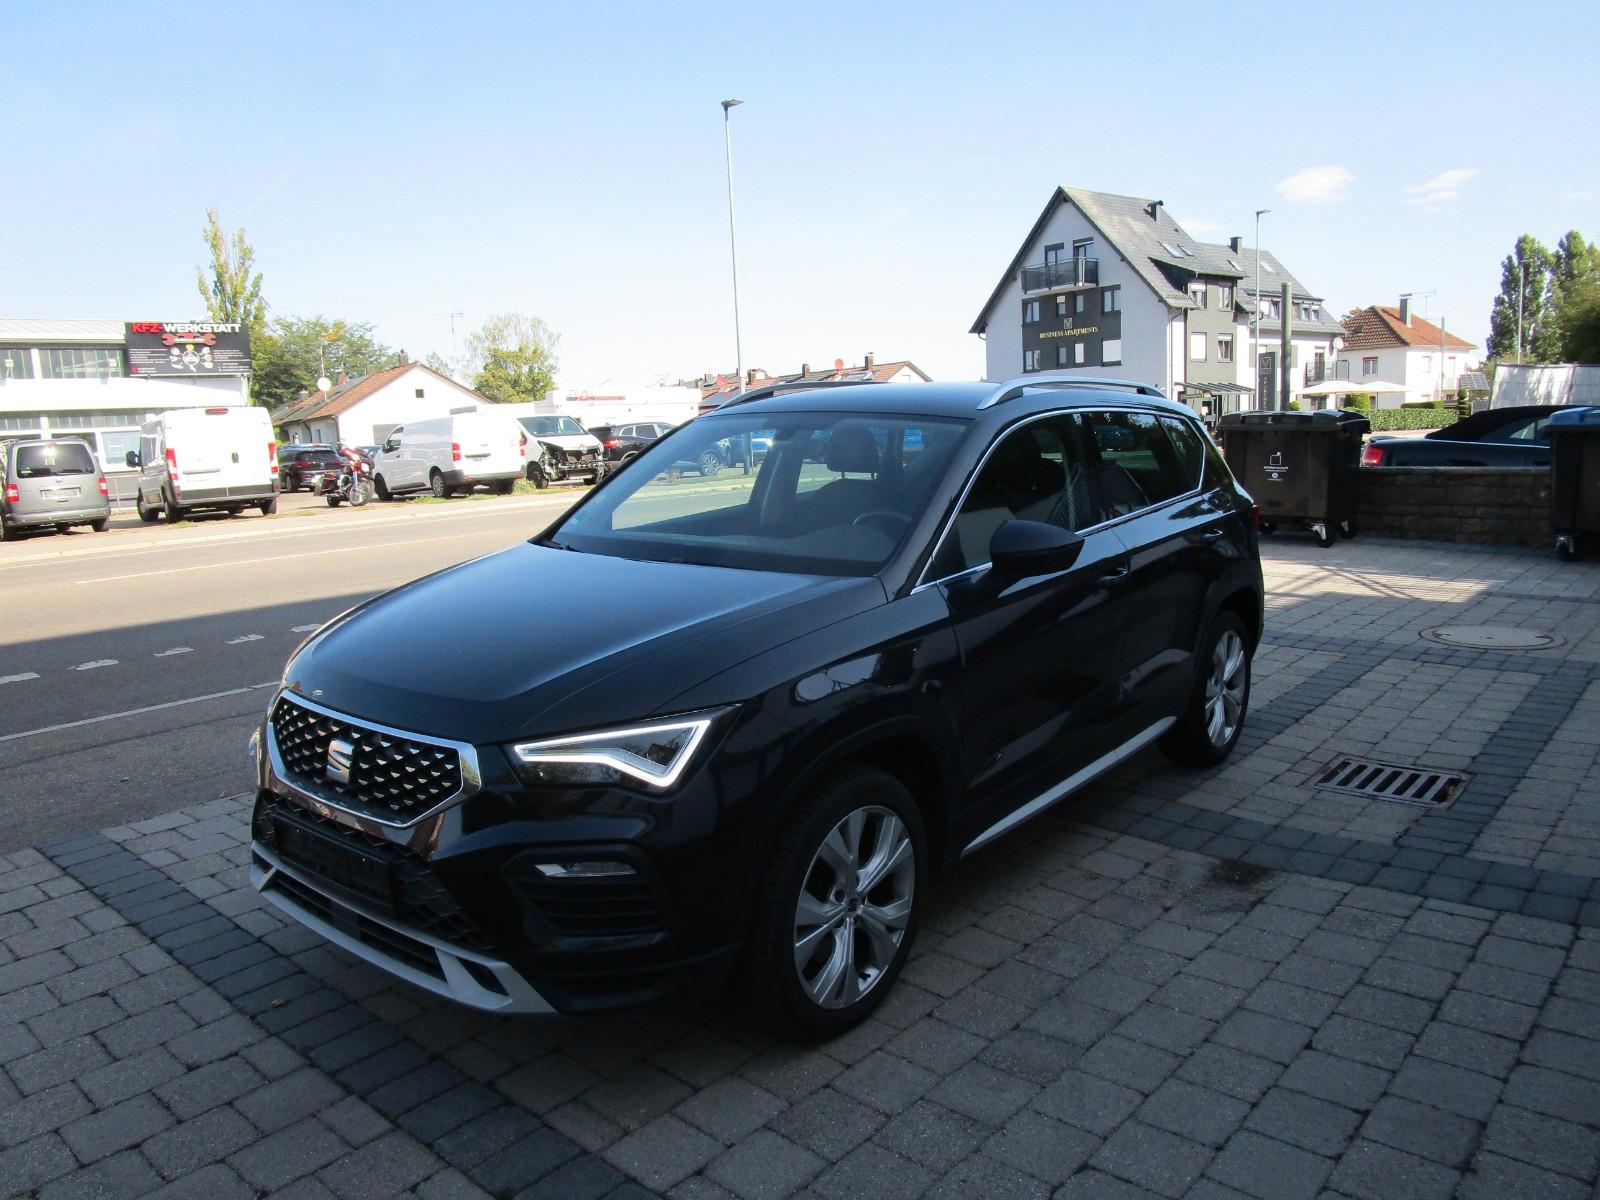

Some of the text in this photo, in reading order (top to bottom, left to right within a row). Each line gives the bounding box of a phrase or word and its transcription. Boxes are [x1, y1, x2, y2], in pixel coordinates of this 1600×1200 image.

[132, 323, 241, 332] KFZ-WERKSTATT
[1039, 326, 1098, 338] BUSINESS APARTMENTS
